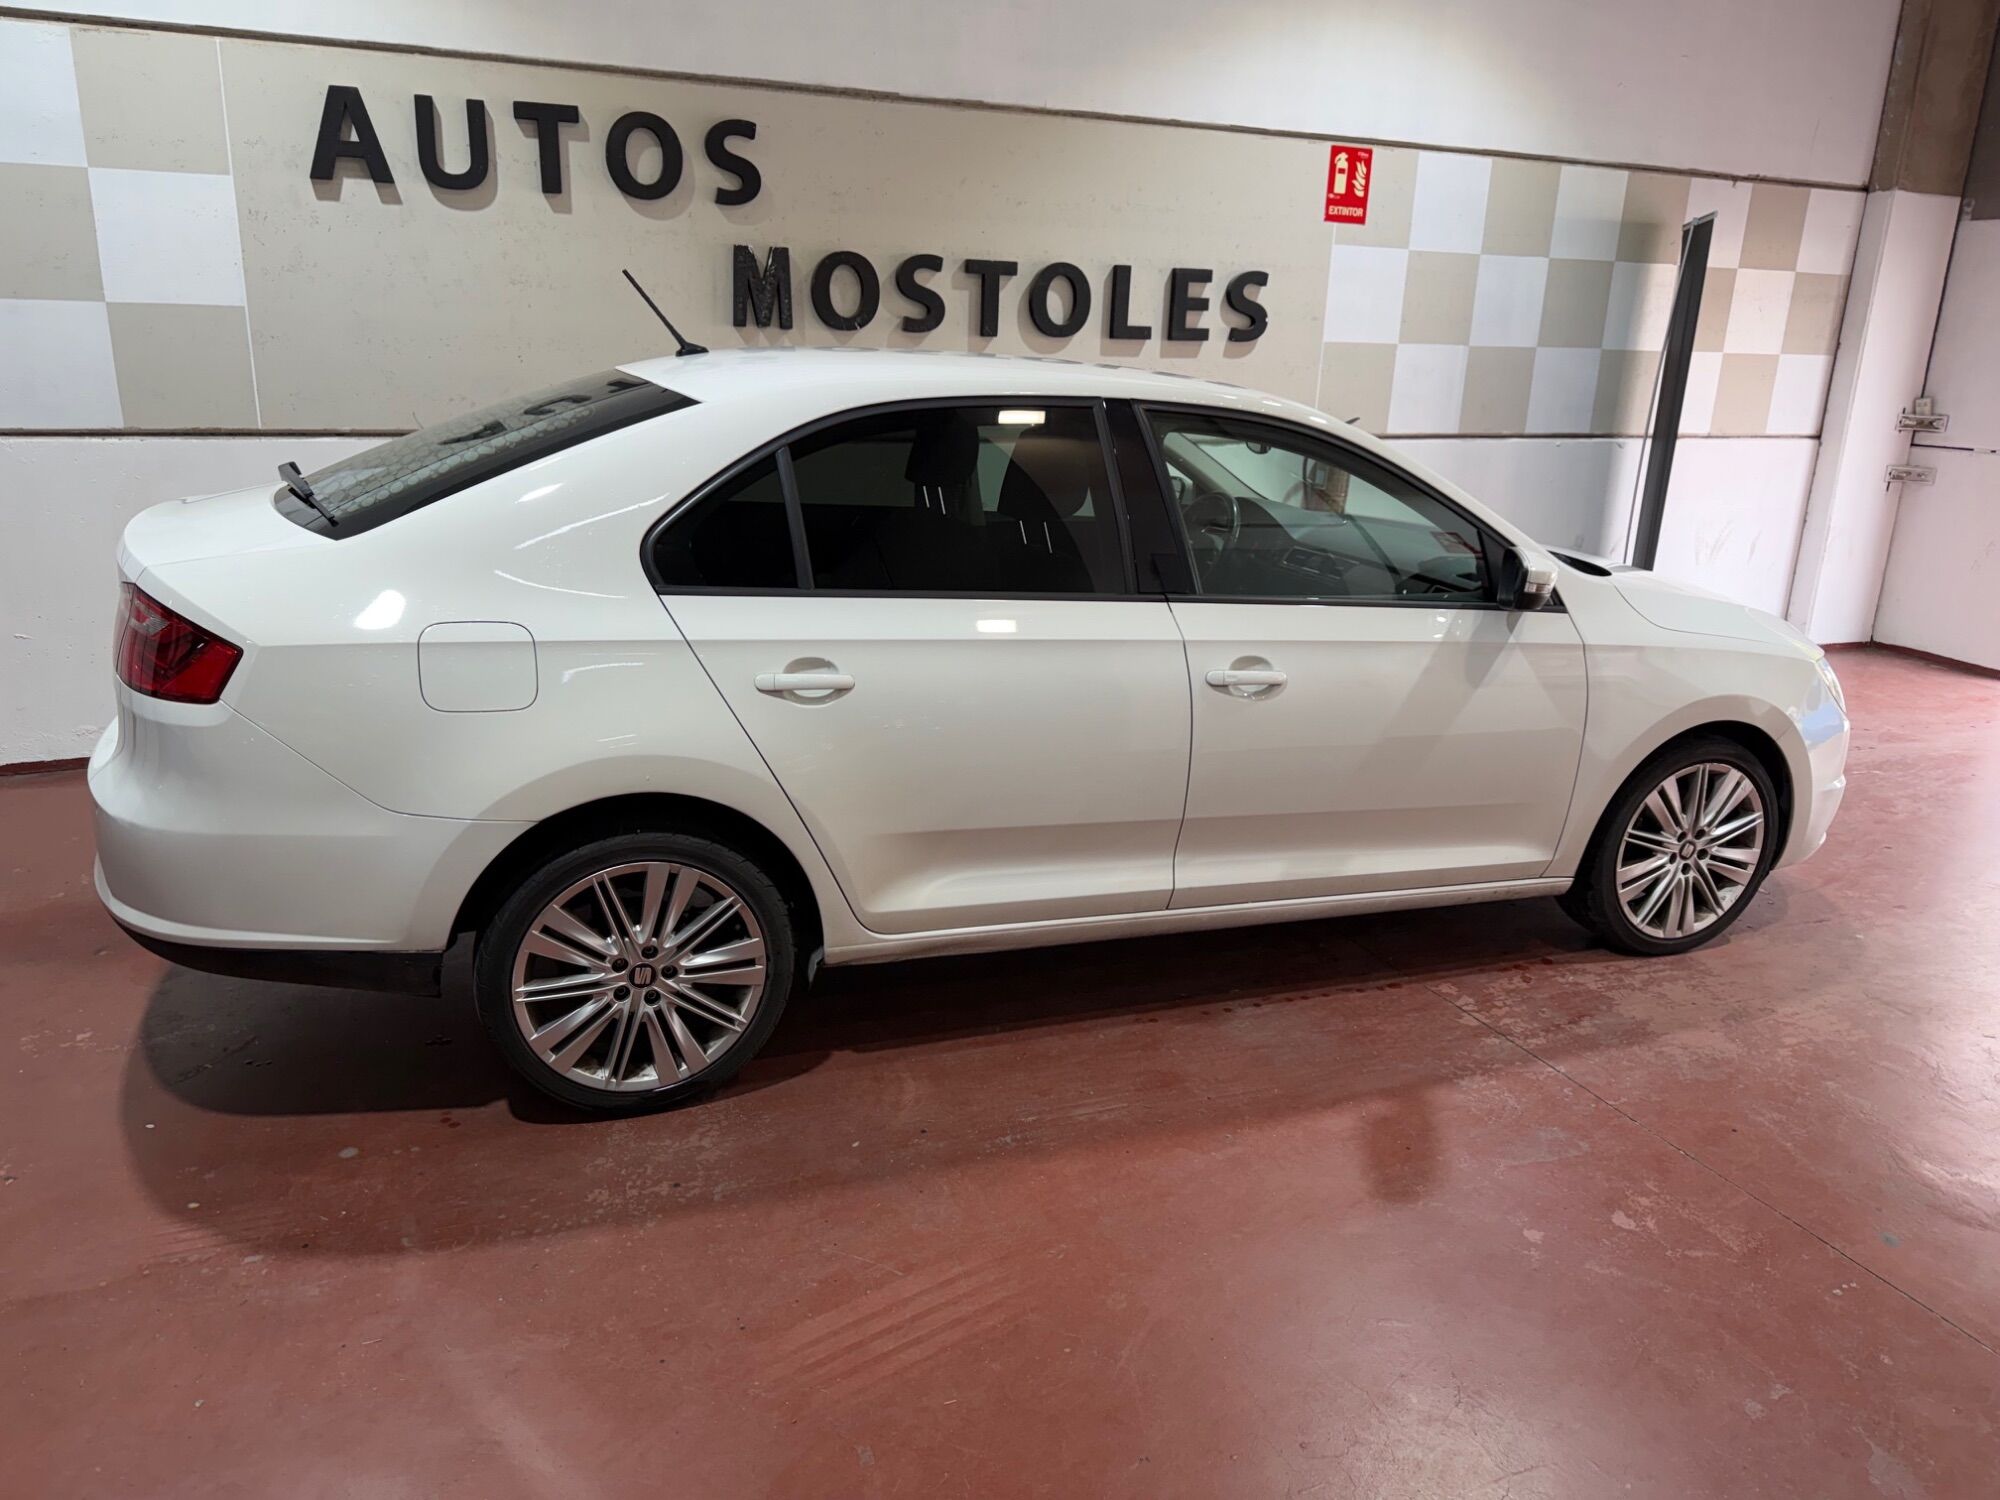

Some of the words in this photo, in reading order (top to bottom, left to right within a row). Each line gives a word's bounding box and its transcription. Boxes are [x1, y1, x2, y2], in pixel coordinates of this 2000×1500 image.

[310, 85, 761, 205] AUTOS
[1328, 205, 1363, 217] EXTINTOR
[732, 244, 1269, 342] MOSTOLES
